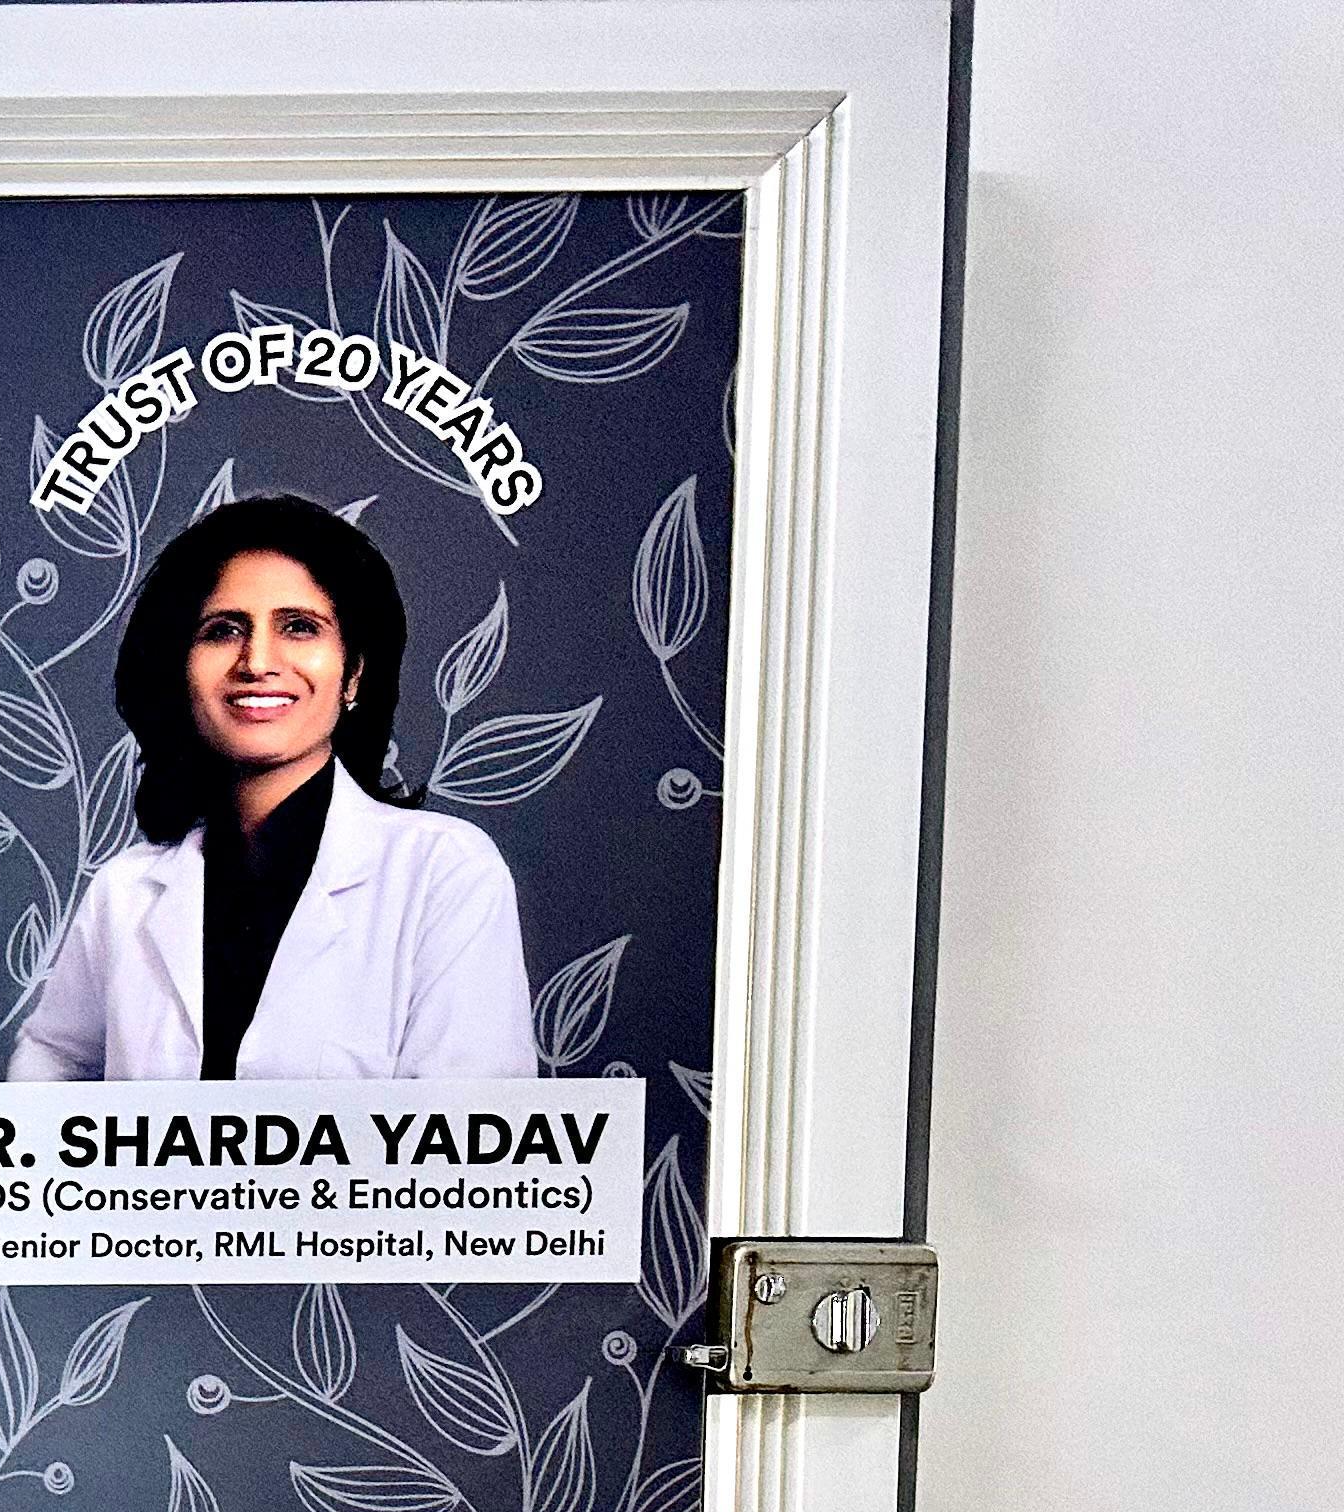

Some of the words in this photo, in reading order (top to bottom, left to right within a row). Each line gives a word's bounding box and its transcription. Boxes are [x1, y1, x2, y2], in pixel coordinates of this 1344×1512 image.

[37, 354, 188, 508] TRUST
[207, 330, 288, 386] OF
[303, 335, 374, 386] 20
[389, 352, 537, 509] YEARS
[57, 1113, 352, 1169] SHARDA
[368, 1111, 611, 1166] YADAV
[41, 1176, 302, 1219] (Conservative
[310, 1177, 340, 1211] &
[347, 1173, 594, 1216] Endodontics)
[90, 1231, 204, 1264] Doctor,
[214, 1230, 287, 1258] RML
[295, 1228, 435, 1264] Hospital,
[444, 1229, 517, 1258] New
[524, 1228, 606, 1257] Delhi
